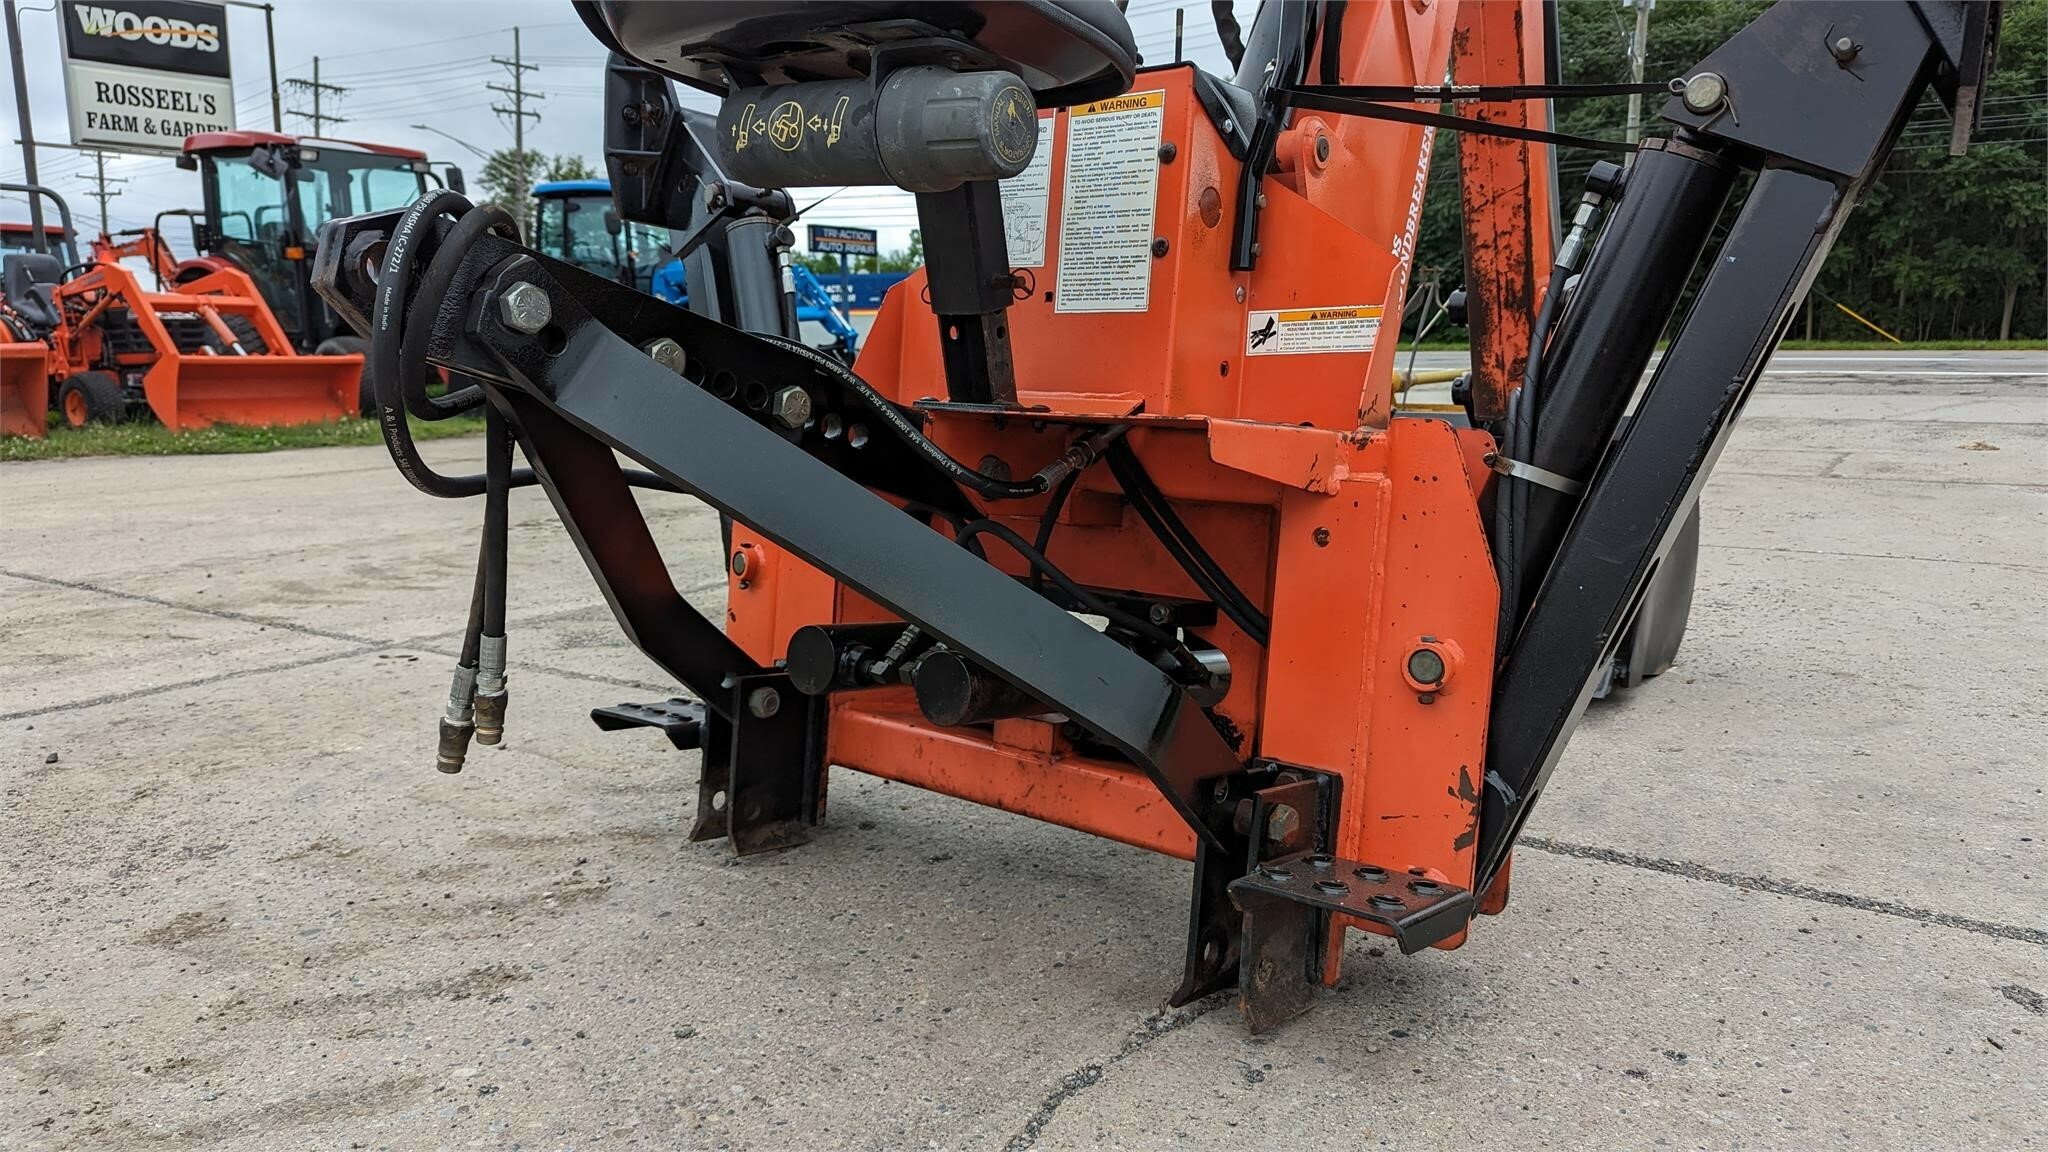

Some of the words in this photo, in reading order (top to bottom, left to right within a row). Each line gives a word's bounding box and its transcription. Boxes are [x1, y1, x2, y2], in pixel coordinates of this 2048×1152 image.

[74, 4, 220, 52] WOODS
[95, 81, 216, 116] ROSSEEL'S
[1100, 97, 1147, 111] WARNING
[86, 112, 138, 133] FARM
[144, 117, 157, 135] &
[993, 100, 1005, 136] MANUAL
[416, 202, 427, 212] PSI
[1399, 126, 1434, 295] NDBREAKER
[402, 211, 420, 234] MSHA
[823, 228, 872, 240] TRI-ACTION
[389, 234, 409, 273] IC-272/1
[818, 242, 842, 252] AUTO
[845, 244, 874, 254] REPAIR
[383, 304, 388, 314] in
[1319, 310, 1357, 319] WARNING
[792, 345, 816, 360] MSHA
[814, 355, 826, 365] PSI
[826, 362, 842, 374] 4800
[856, 386, 870, 397] 3/8"
[389, 428, 404, 456] Products
[908, 431, 921, 444] SAE
[922, 442, 946, 466] Products
